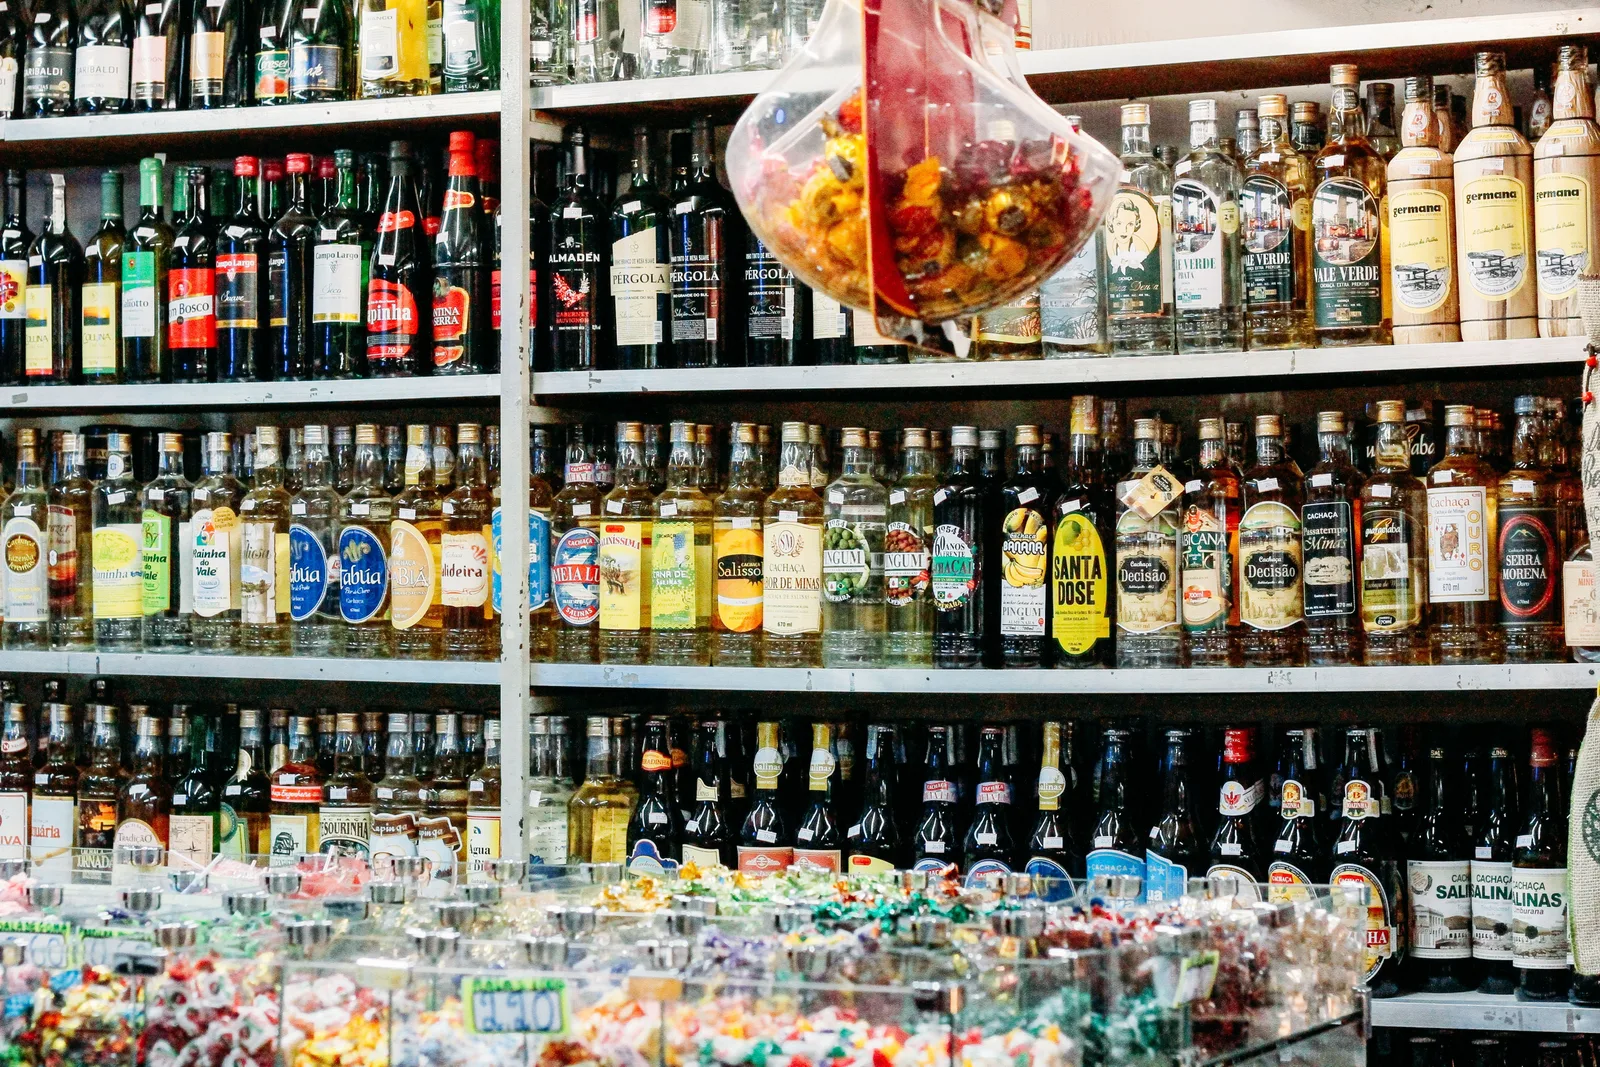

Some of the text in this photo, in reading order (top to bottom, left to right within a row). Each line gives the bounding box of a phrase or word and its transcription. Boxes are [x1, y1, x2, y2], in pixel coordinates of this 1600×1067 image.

[1466, 188, 1517, 205] germana
[1393, 204, 1441, 218] germana
[315, 251, 359, 260] Campo Largo
[549, 252, 600, 264] ALMADÉN
[1256, 251, 1291, 265] VERDE
[233, 259, 255, 268] Largo
[1184, 257, 1217, 270] VERDE
[612, 272, 665, 285] PÉRGOLA
[669, 268, 720, 283] PÉRGOLA
[744, 266, 795, 280] PÉRGOLA
[1314, 265, 1379, 282] VALE VERDE
[179, 302, 210, 315] Bosco
[434, 315, 459, 326] SERRA
[1430, 496, 1470, 508] Cachaça
[1307, 511, 1338, 520] CACHAÇA
[937, 525, 958, 534] 1954
[1303, 526, 1348, 537] Passatempo
[567, 537, 593, 546] CACHAÇA
[945, 542, 966, 551] ANOS
[1303, 536, 1347, 551] Minas
[1467, 510, 1482, 571] OURO
[193, 548, 226, 558] Rainha
[1003, 540, 1044, 555] BANANA
[825, 550, 862, 564] NGUM
[886, 553, 924, 568] NGUM
[1505, 554, 1542, 566] SERRA
[196, 566, 216, 576] Vale
[769, 563, 806, 573] CACHAÇA
[1054, 555, 1102, 580] SANTA
[1247, 564, 1296, 578] Decisão
[1502, 567, 1547, 580] MORENA
[553, 566, 600, 582] MEIA LU
[673, 570, 687, 578] DE
[1120, 568, 1166, 582] Decisão
[780, 576, 792, 589] DE
[795, 577, 820, 590] MINAS
[1442, 583, 1460, 591] 670 ml
[1578, 577, 1595, 586] MINE
[1057, 581, 1096, 606] DOSE
[565, 605, 593, 617] SALINAS
[1002, 606, 1041, 617] PINGUM
[811, 763, 833, 772] alinas
[1039, 783, 1063, 791] alinas
[0, 835, 22, 846] IVA
[1091, 864, 1128, 872] CACHAÇA
[1513, 907, 1544, 915] mburana
